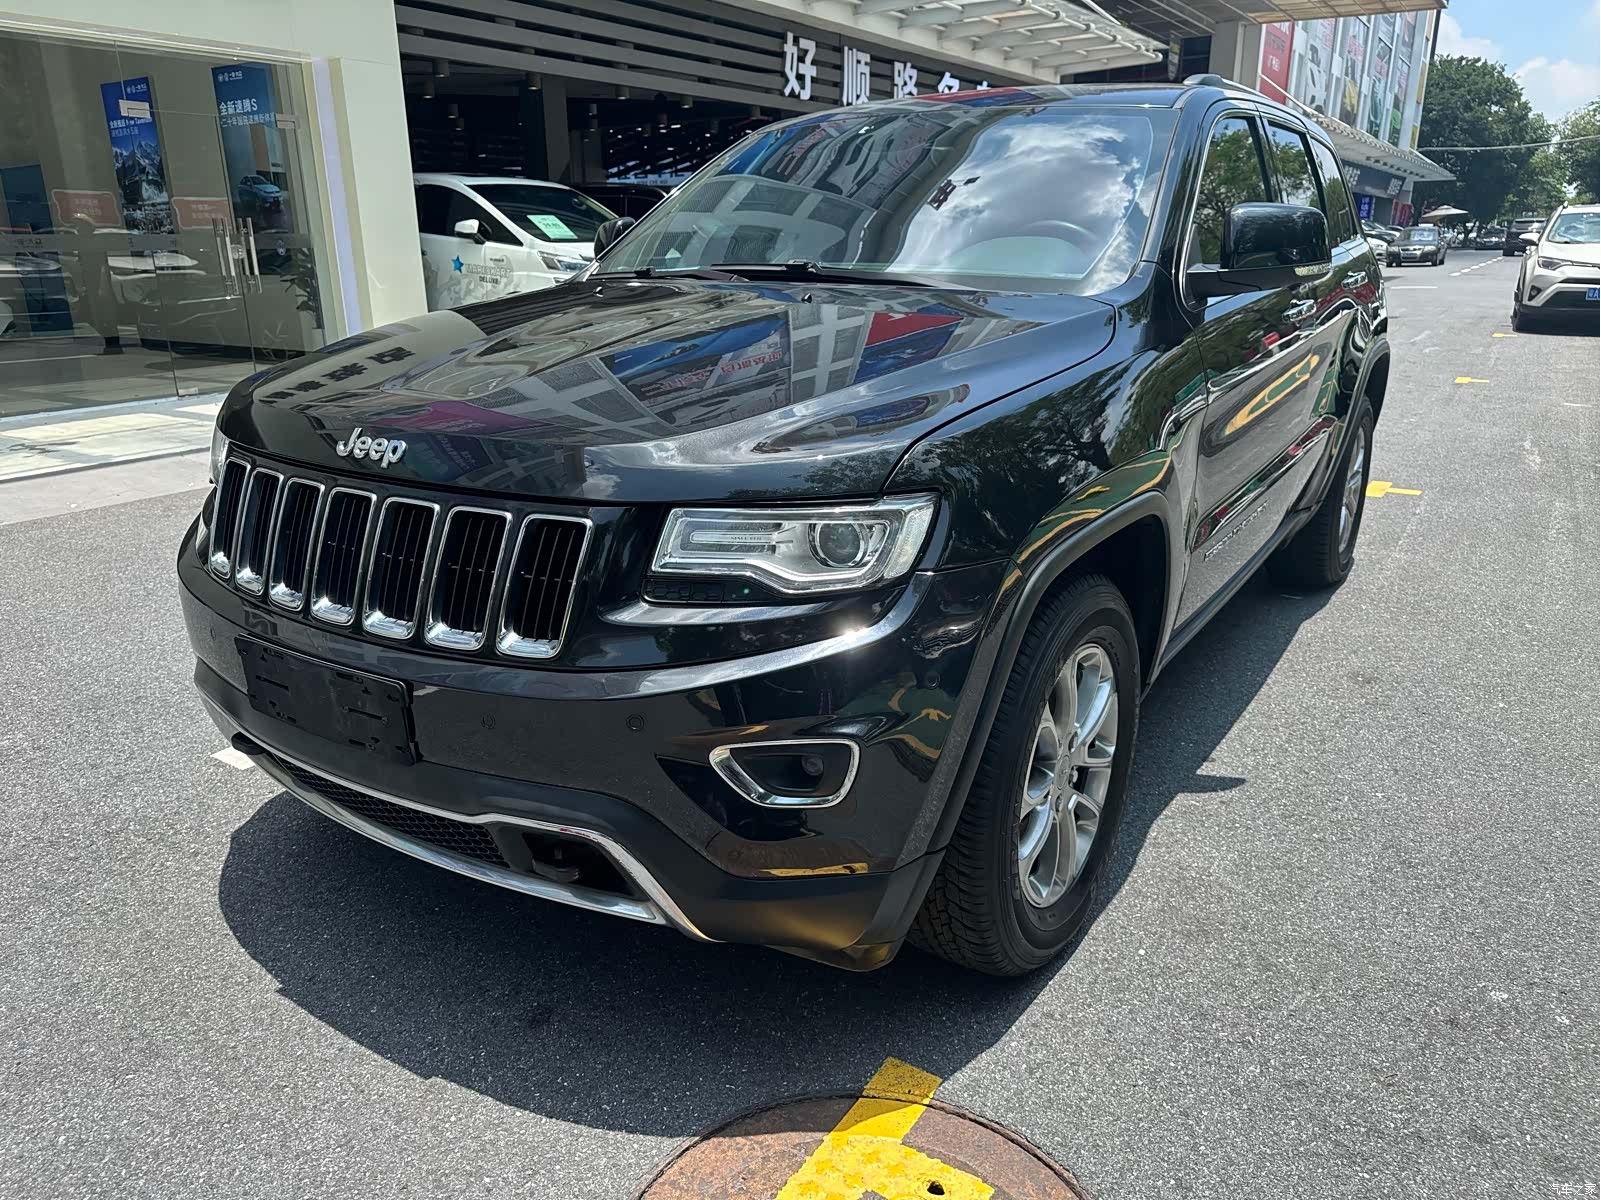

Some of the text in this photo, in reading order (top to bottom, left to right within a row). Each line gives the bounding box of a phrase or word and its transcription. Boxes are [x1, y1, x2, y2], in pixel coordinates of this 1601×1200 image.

[784, 32, 989, 106] 好顺路
[336, 427, 408, 469] Jeep
